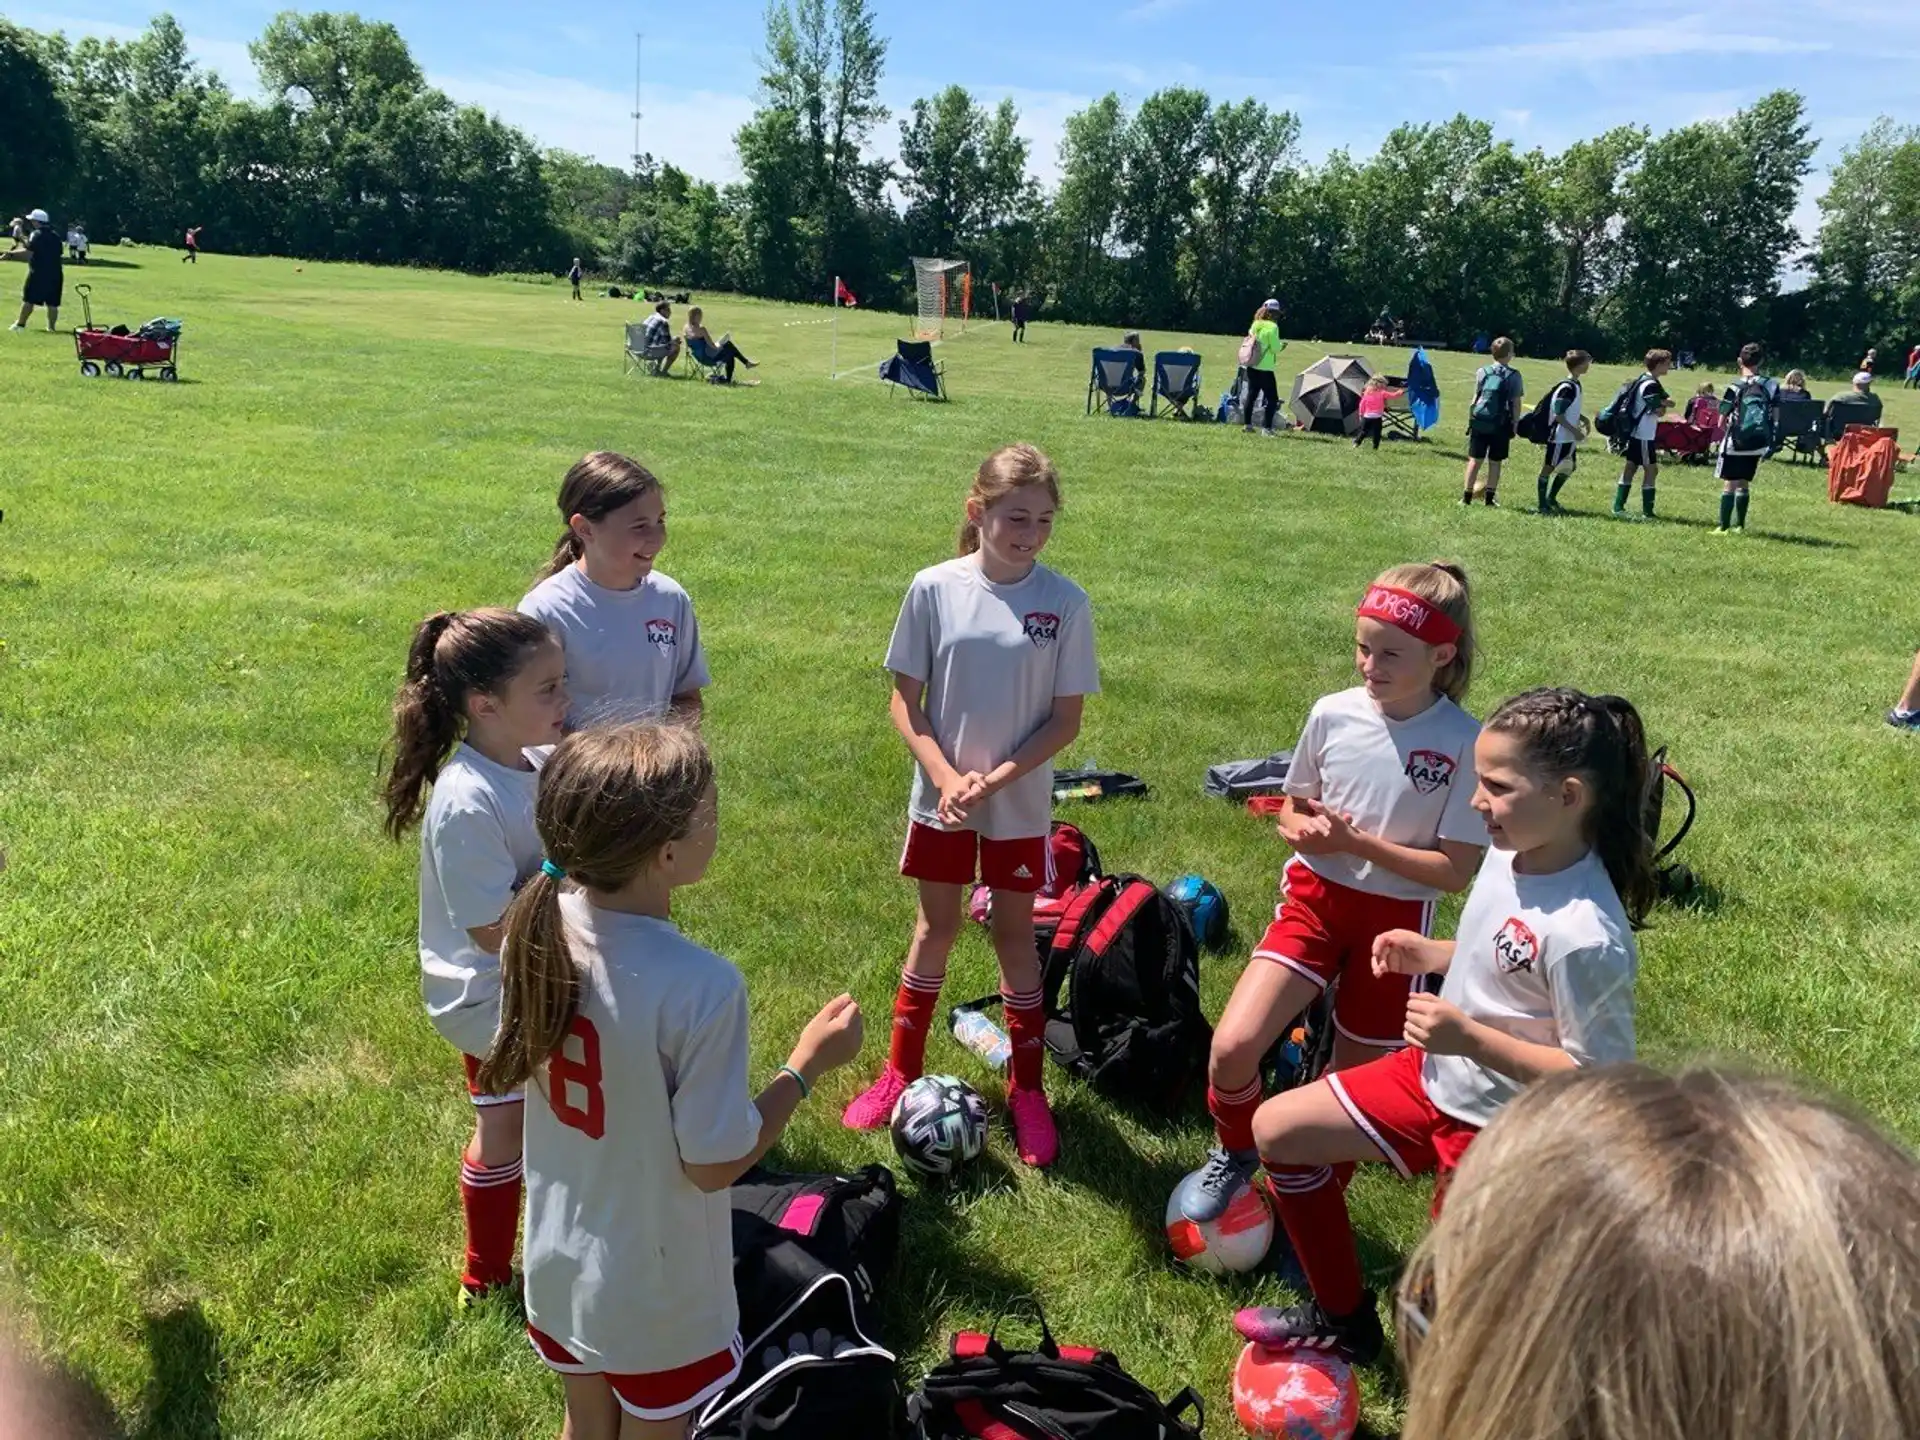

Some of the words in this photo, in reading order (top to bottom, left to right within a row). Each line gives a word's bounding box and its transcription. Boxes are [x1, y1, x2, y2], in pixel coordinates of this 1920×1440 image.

[1362, 587, 1430, 631] MORGAN
[1404, 763, 1449, 786] KASA
[1492, 929, 1532, 974] KASA
[547, 1014, 606, 1141] 8
